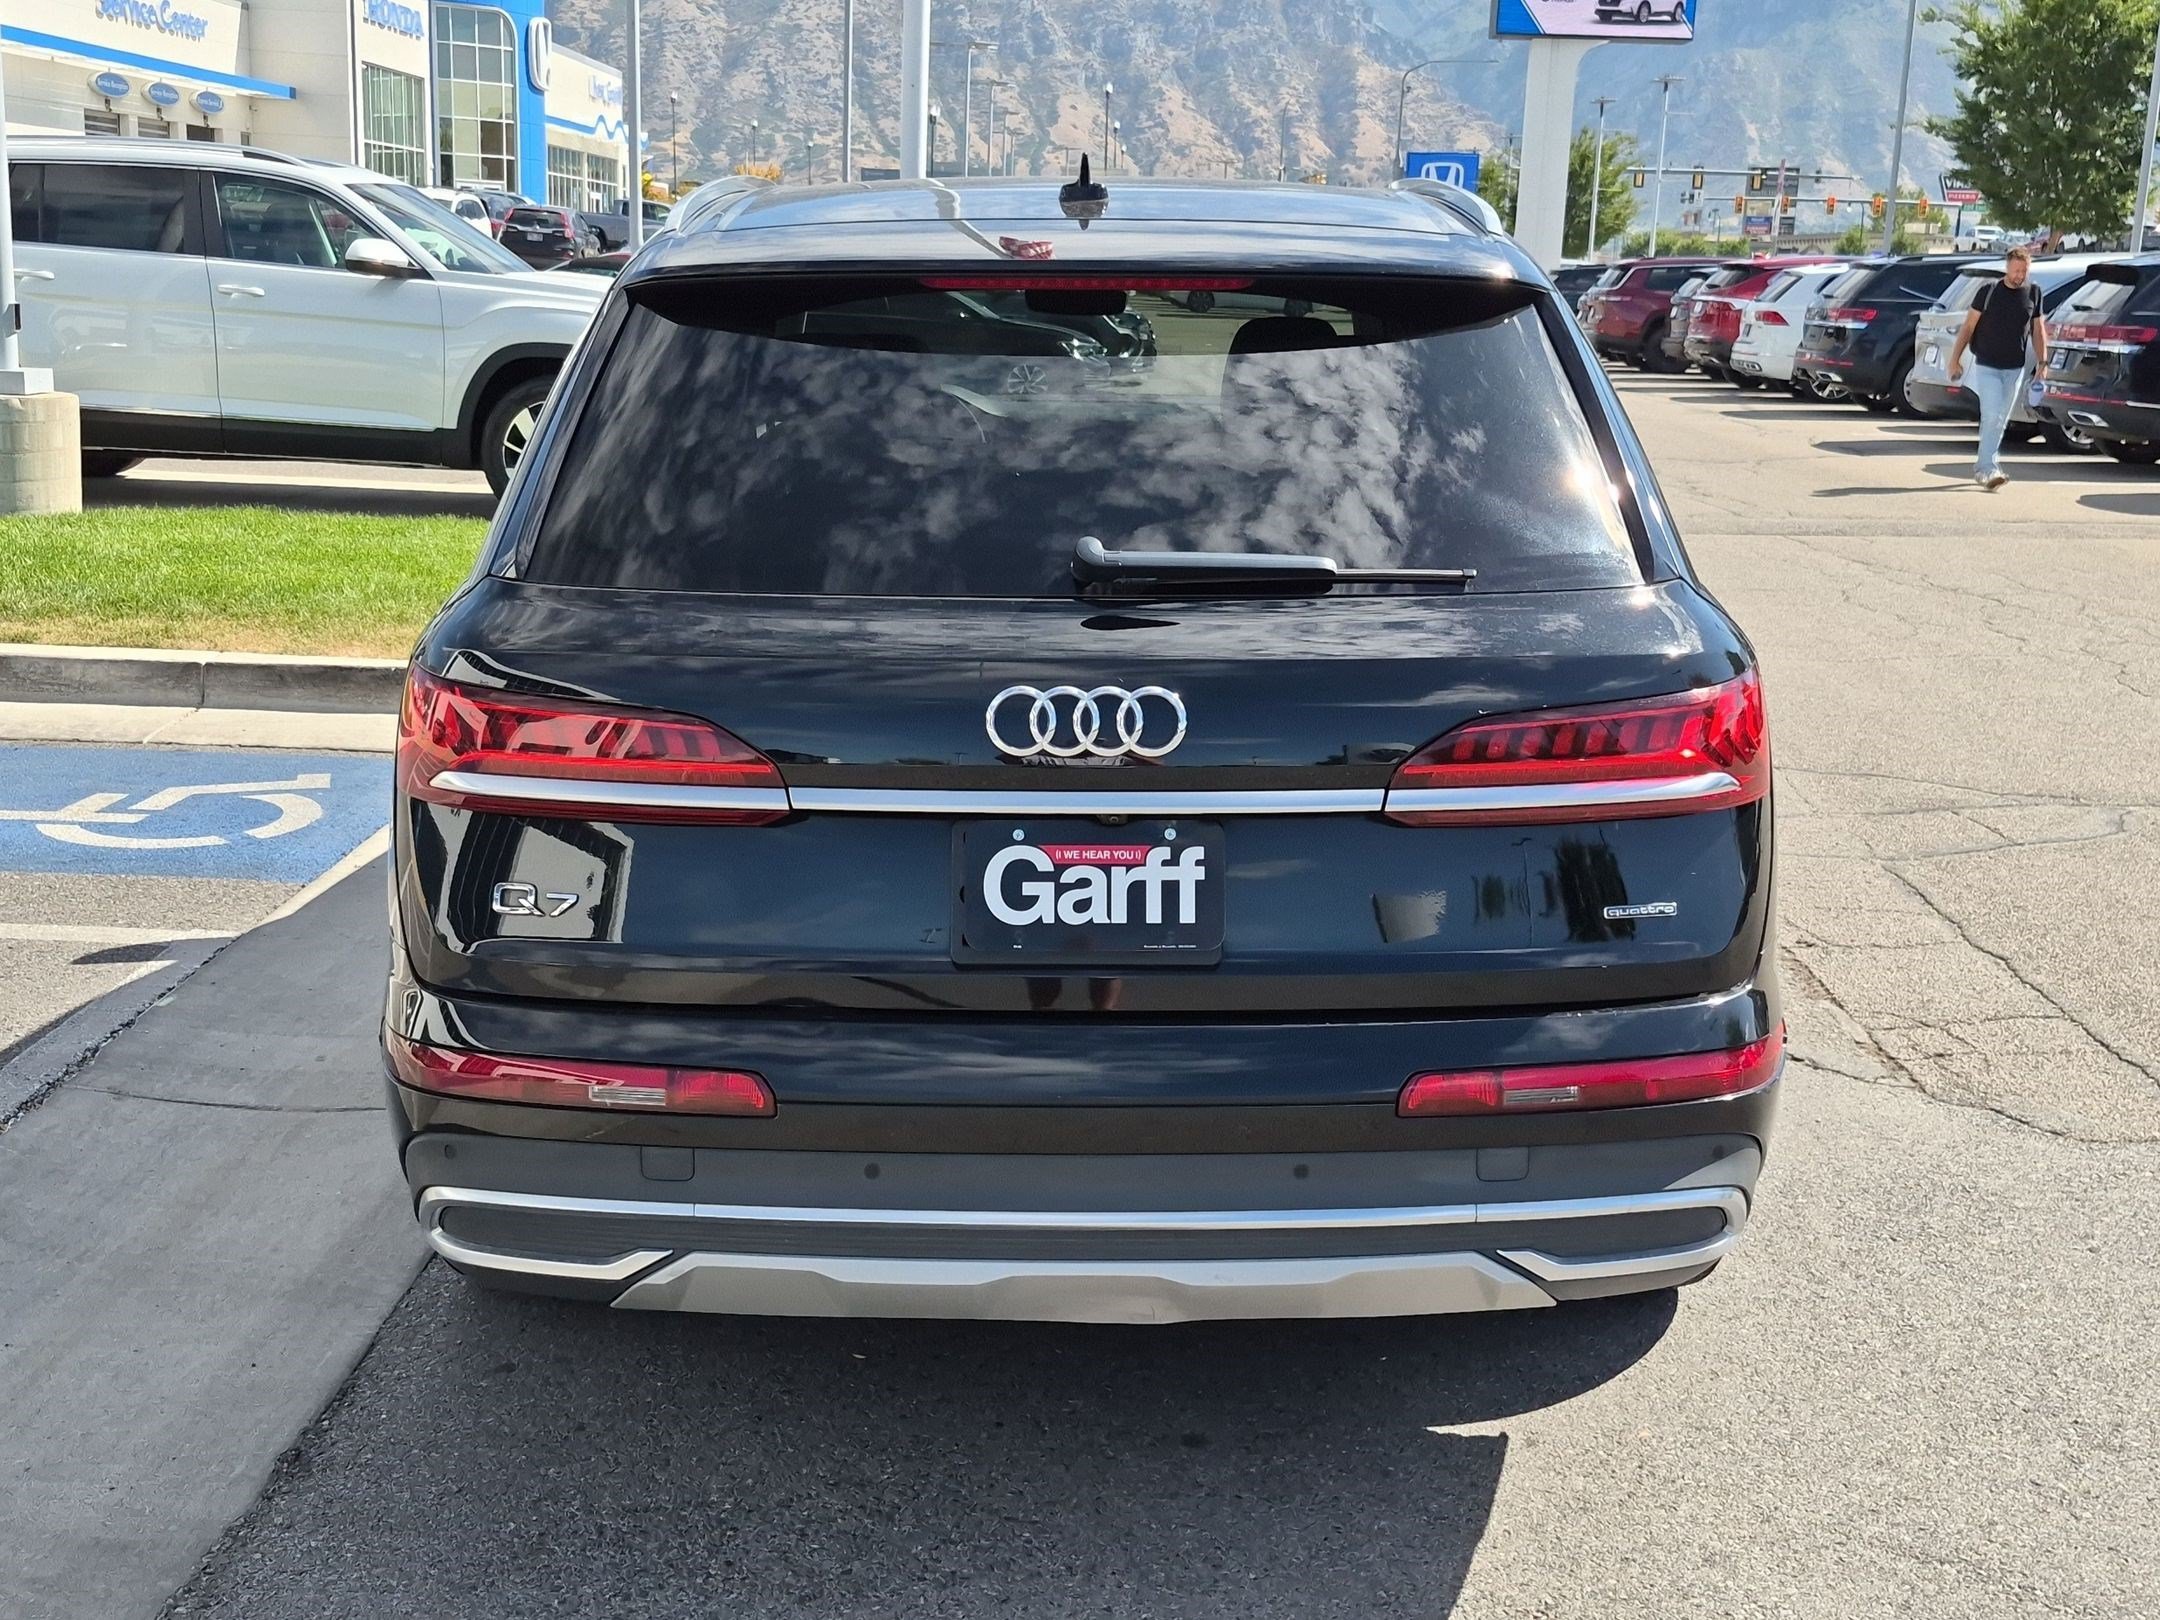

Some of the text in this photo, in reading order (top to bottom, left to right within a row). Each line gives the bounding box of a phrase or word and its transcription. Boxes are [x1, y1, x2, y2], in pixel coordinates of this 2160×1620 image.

[159, 0, 208, 41] Center
[363, 0, 424, 40] HONDA
[1063, 850, 1134, 860] WE HEAR YOU
[492, 882, 579, 917] Q7
[983, 845, 1205, 926] Garff
[1608, 905, 1674, 917] quattro
